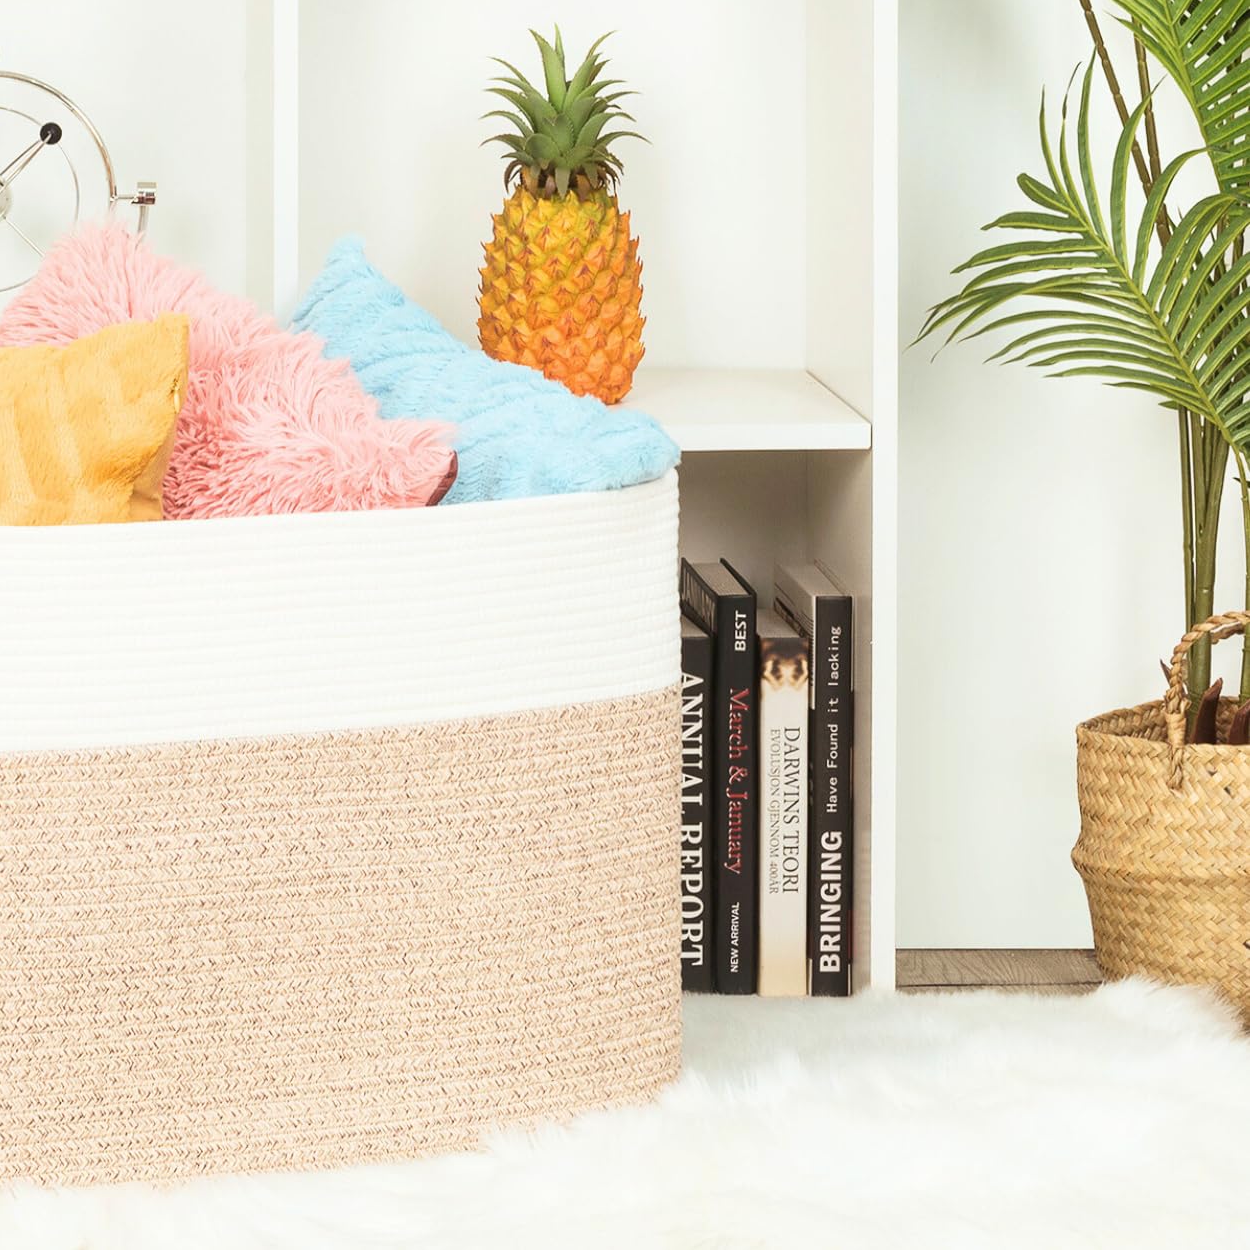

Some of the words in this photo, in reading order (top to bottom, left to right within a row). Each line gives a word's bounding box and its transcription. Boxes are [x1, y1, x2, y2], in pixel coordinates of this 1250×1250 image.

[734, 610, 748, 652] BEST
[827, 626, 842, 687] lacking
[729, 687, 750, 761] March
[826, 697, 839, 713] it
[728, 764, 748, 785] &
[768, 728, 781, 797] EVOLUSJON
[783, 726, 801, 824] DARWINS
[825, 723, 839, 769] Found
[825, 776, 839, 813] Have
[723, 787, 748, 875] January
[767, 799, 780, 858] GJENNOM
[782, 829, 799, 894] TEORI
[680, 821, 705, 967] REPORT
[731, 900, 741, 943] ARRIVAL
[819, 829, 844, 973] BRINGING
[730, 944, 740, 974] NEW
